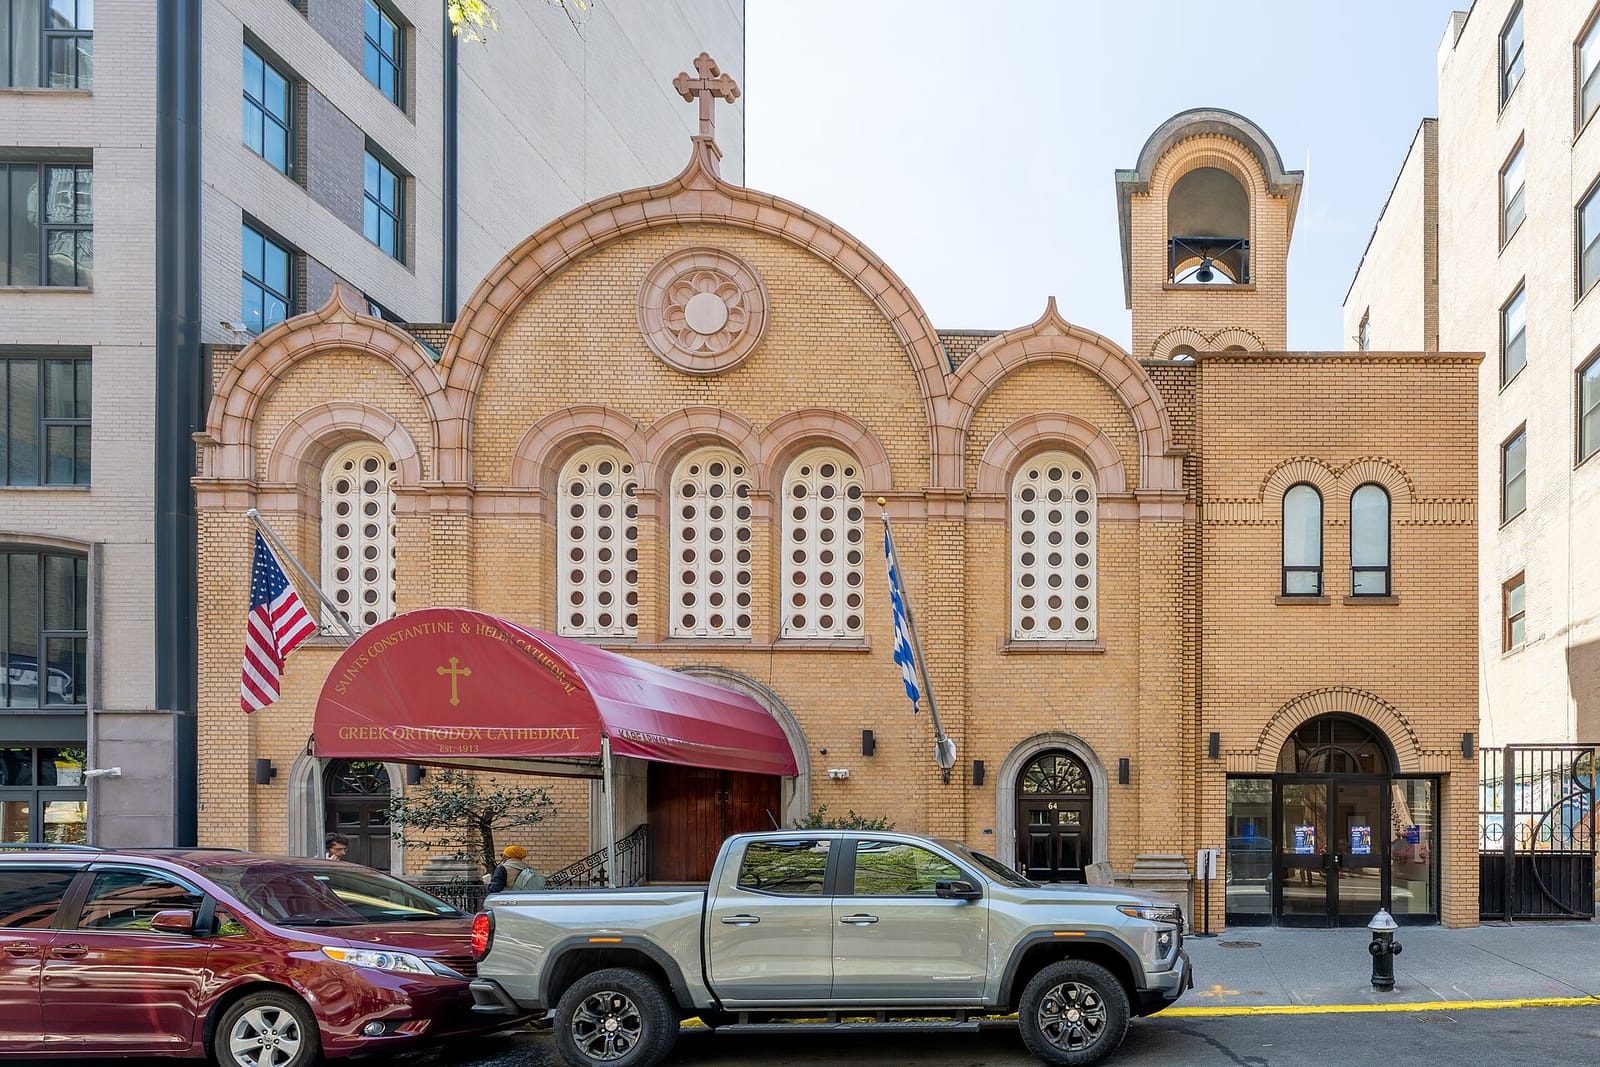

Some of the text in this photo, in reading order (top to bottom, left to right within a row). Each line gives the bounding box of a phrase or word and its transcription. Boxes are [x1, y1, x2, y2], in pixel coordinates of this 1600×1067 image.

[335, 654, 369, 695] SAINTS
[367, 622, 454, 658] CONSTANTINE
[460, 622, 471, 634] &
[338, 726, 580, 740] GREEK ORTHODOX CATHEDRAL
[459, 744, 480, 753] 1913
[1048, 801, 1058, 810] 64
